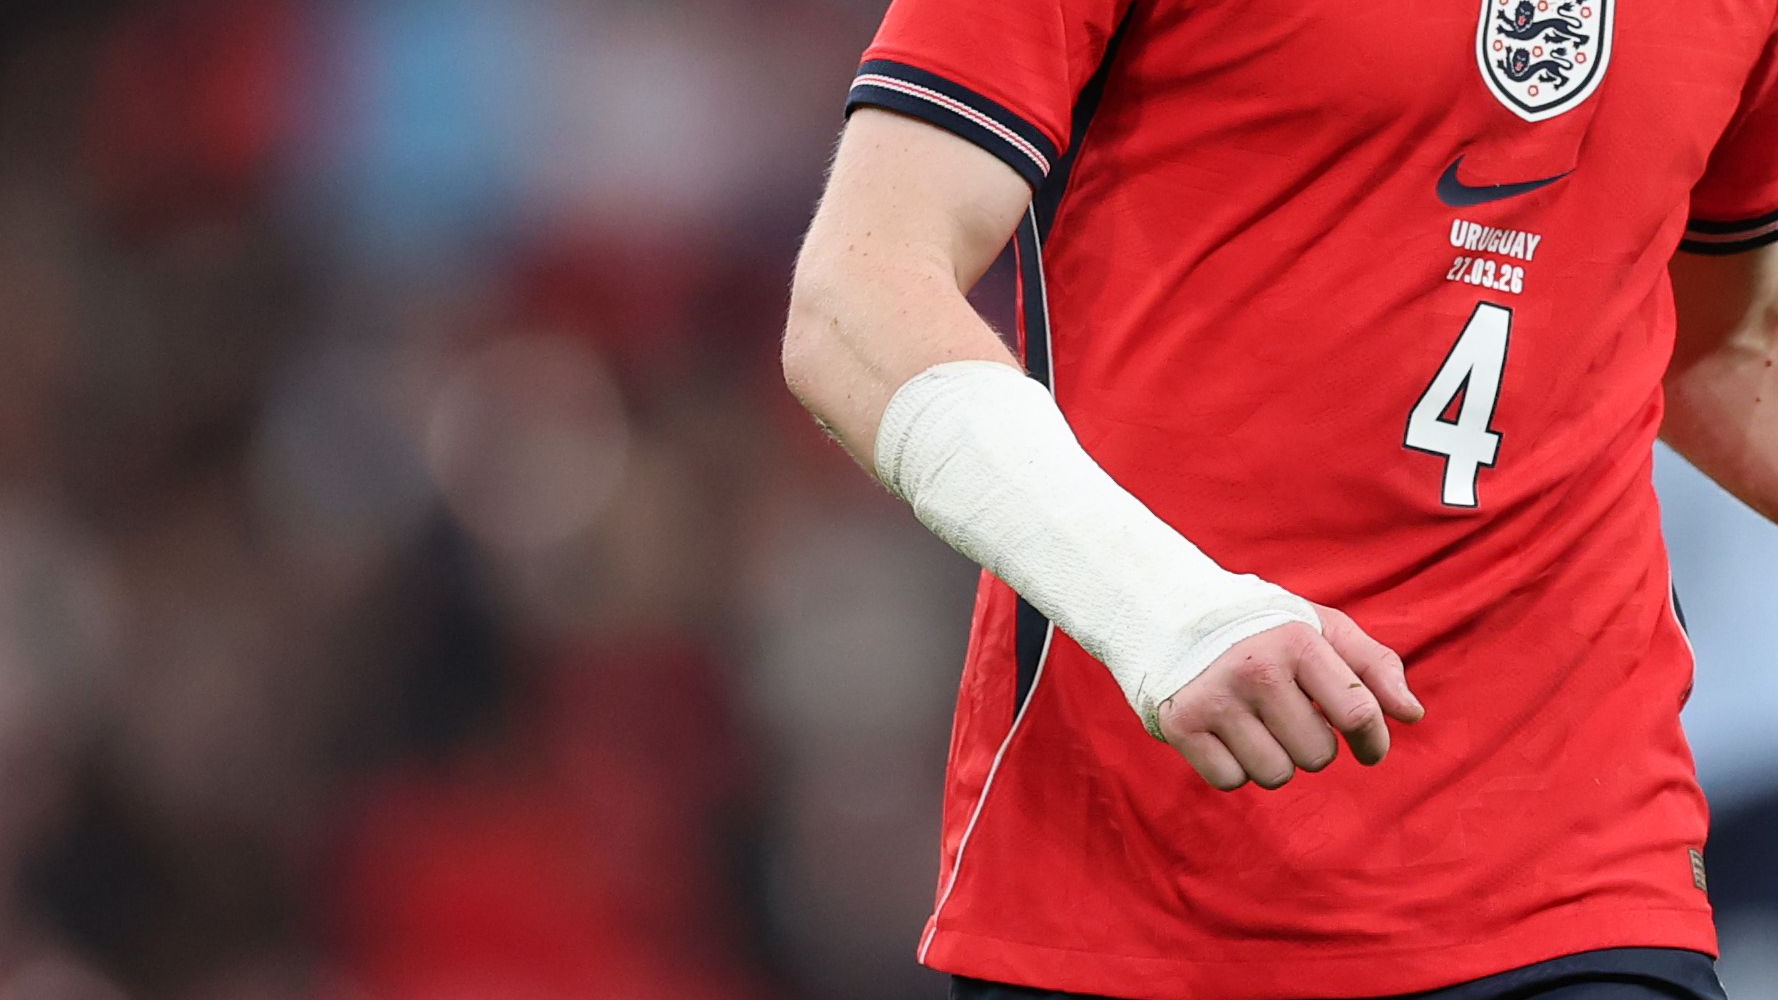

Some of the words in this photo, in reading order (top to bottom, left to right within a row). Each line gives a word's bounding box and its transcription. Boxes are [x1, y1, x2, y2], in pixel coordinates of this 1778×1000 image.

[1450, 218, 1541, 261] URUGUAY
[1446, 256, 1524, 294] 27.03.26
[1403, 300, 1513, 508] 4
